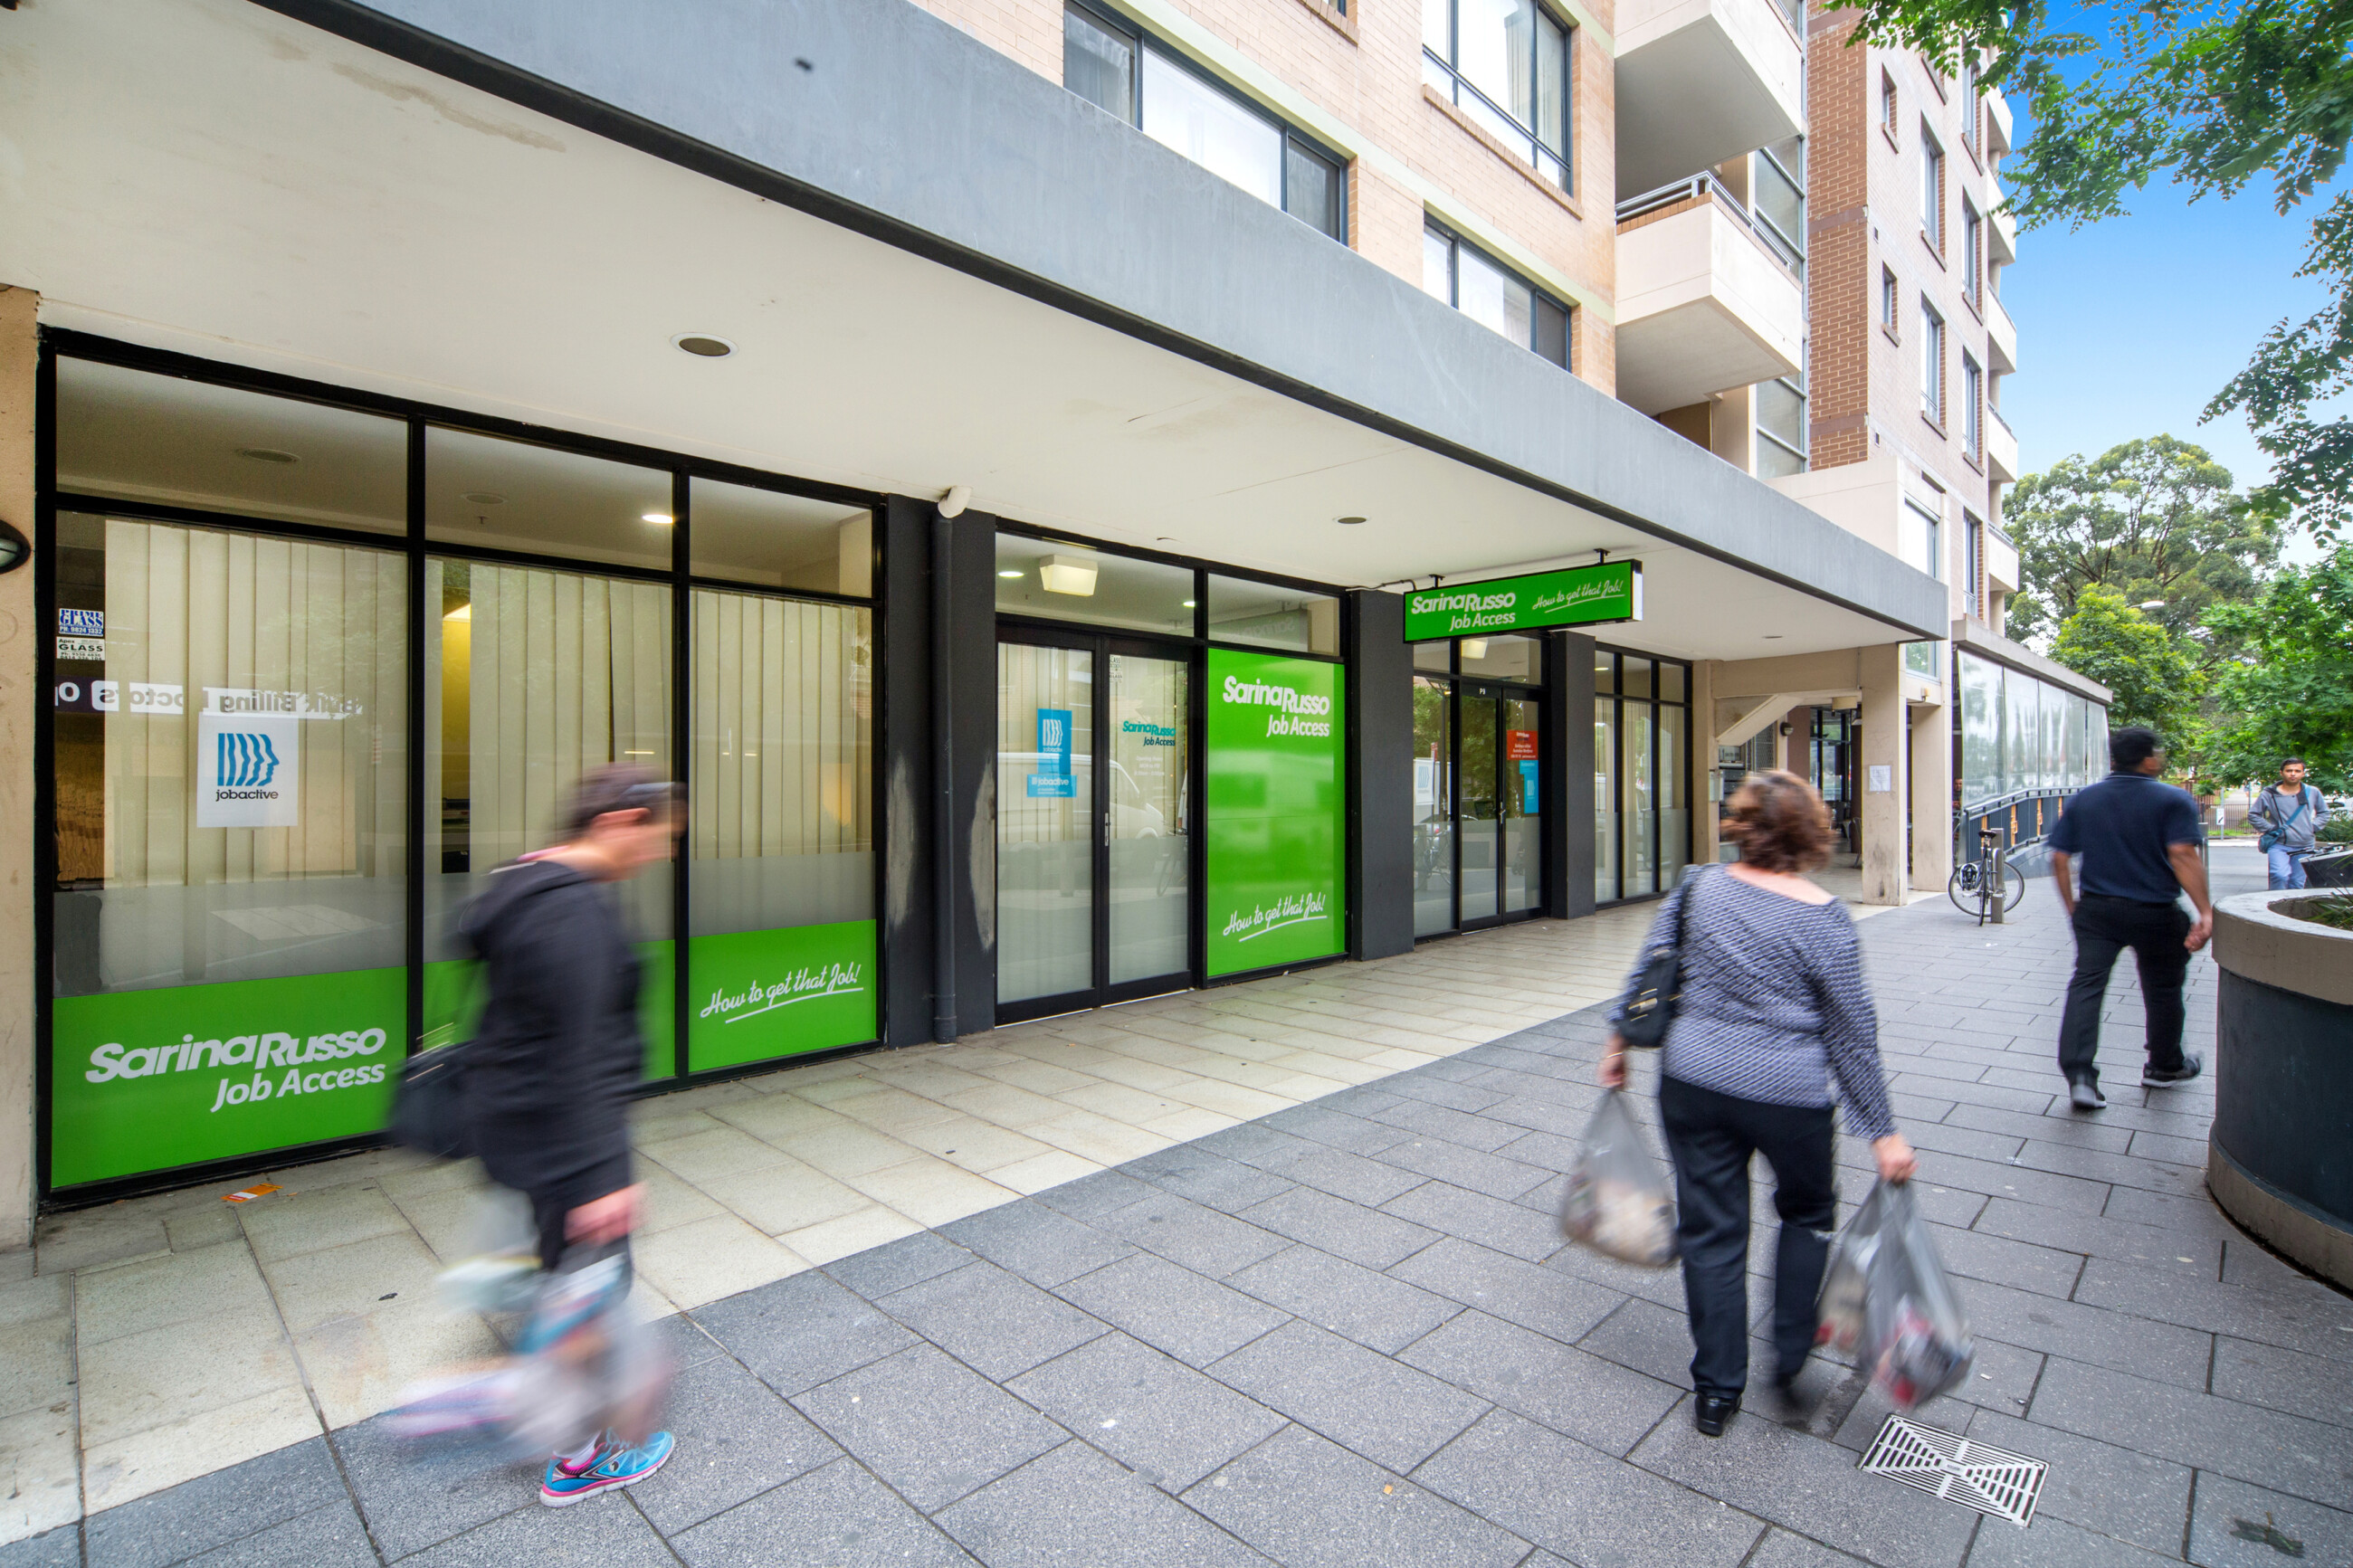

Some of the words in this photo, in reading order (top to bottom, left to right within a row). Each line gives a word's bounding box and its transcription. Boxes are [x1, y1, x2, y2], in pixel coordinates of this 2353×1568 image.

[1532, 594, 1556, 610] How
[1557, 590, 1566, 603] to
[1567, 584, 1580, 605] get
[1581, 582, 1602, 597] that
[1601, 579, 1624, 598] Job!
[60, 614, 103, 627] GLASS
[61, 609, 103, 617] PRIME
[1449, 613, 1472, 632] Job
[1472, 613, 1516, 628] Access
[58, 643, 103, 652] GLASS
[1266, 714, 1289, 737] Job
[1290, 716, 1330, 737] Access
[1143, 736, 1155, 746] Job
[1155, 737, 1176, 746] Access
[1038, 776, 1069, 787] jobactive
[215, 789, 279, 802] jobactive
[1223, 910, 1253, 936] How
[1253, 904, 1264, 925] to
[1265, 898, 1281, 929] get
[1282, 894, 1304, 917] that
[1304, 891, 1326, 919] Job!
[700, 988, 747, 1019] How
[748, 980, 764, 1003] to
[767, 971, 792, 1007] get
[793, 965, 826, 992] that
[827, 962, 862, 993] Job!
[210, 1072, 272, 1113] Job
[276, 1063, 386, 1098] Access
